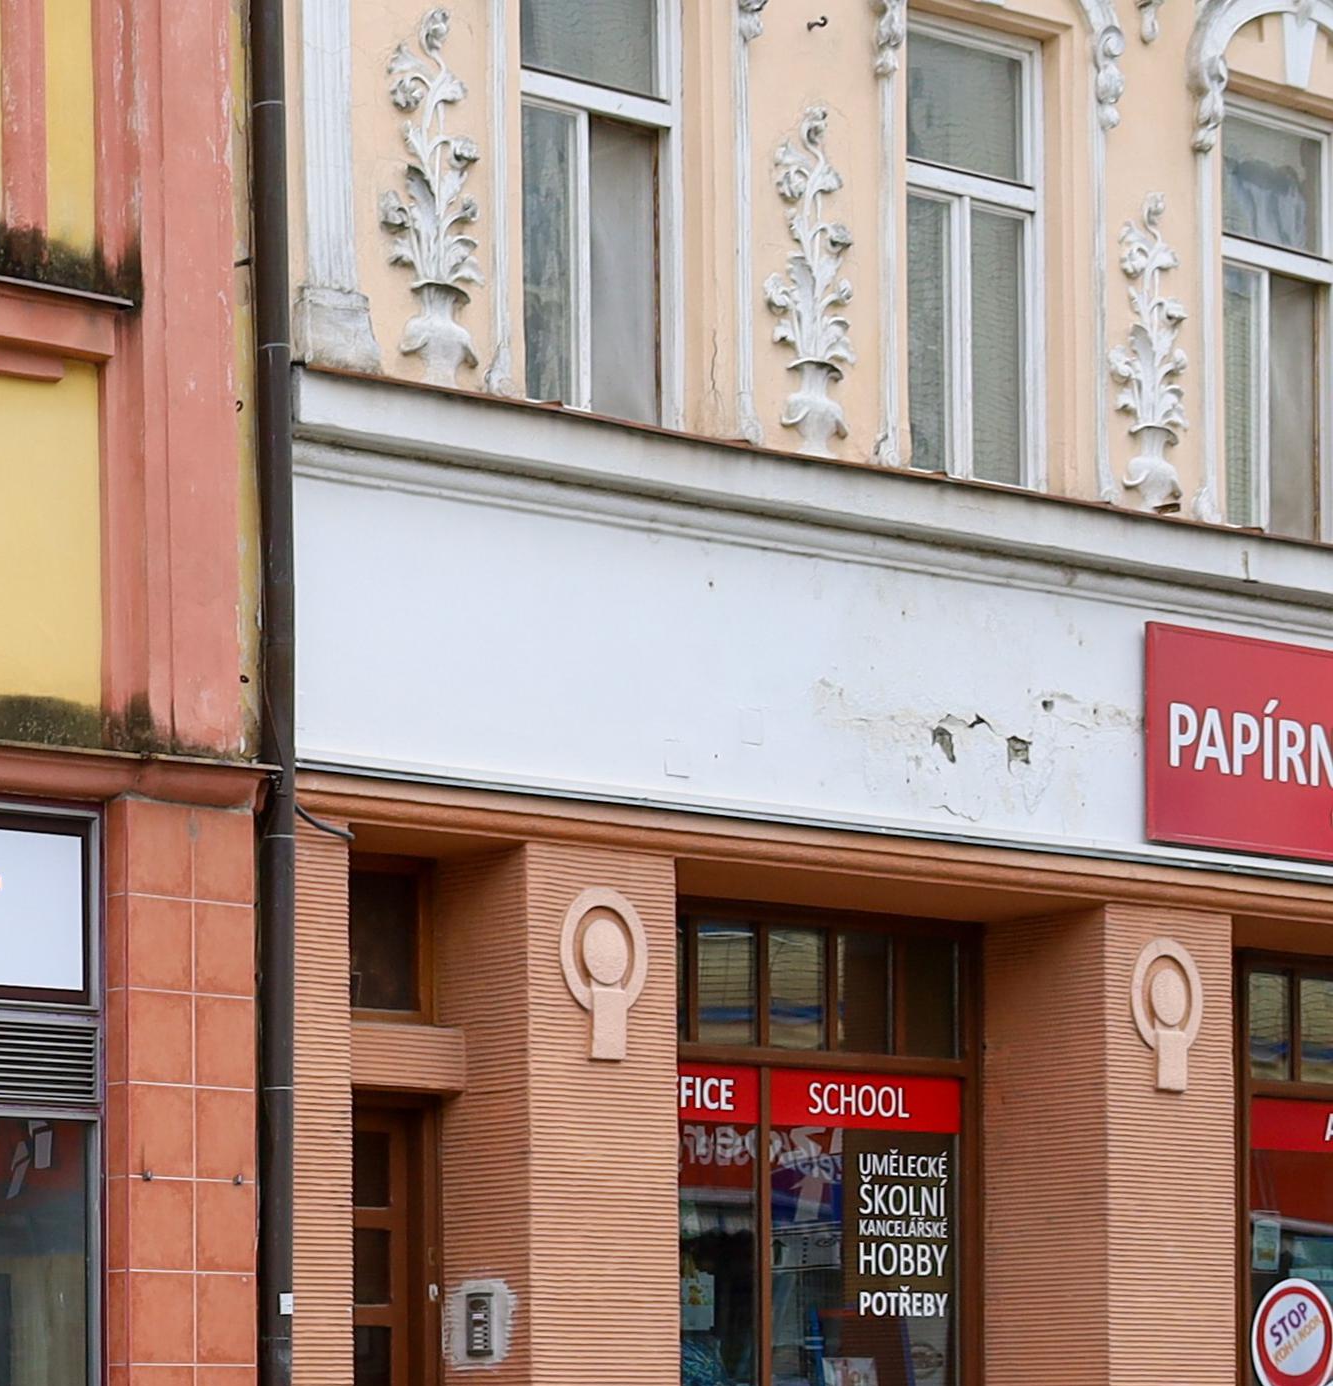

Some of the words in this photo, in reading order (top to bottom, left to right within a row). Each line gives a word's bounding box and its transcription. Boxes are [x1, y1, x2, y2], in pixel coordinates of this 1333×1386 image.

[1168, 698, 1333, 788] PAPÍRN
[674, 1076, 734, 1111] FICE
[808, 1082, 910, 1119] SCHOOL
[858, 1149, 948, 1179] UMĚLECKÉ
[858, 1175, 948, 1217] ŠKOLNÍ
[858, 1217, 948, 1239] KANCELÁŘSKÉ
[858, 1242, 948, 1277] HOBBY
[858, 1285, 949, 1318] POTŘEBY
[1269, 1301, 1308, 1348] STOP
